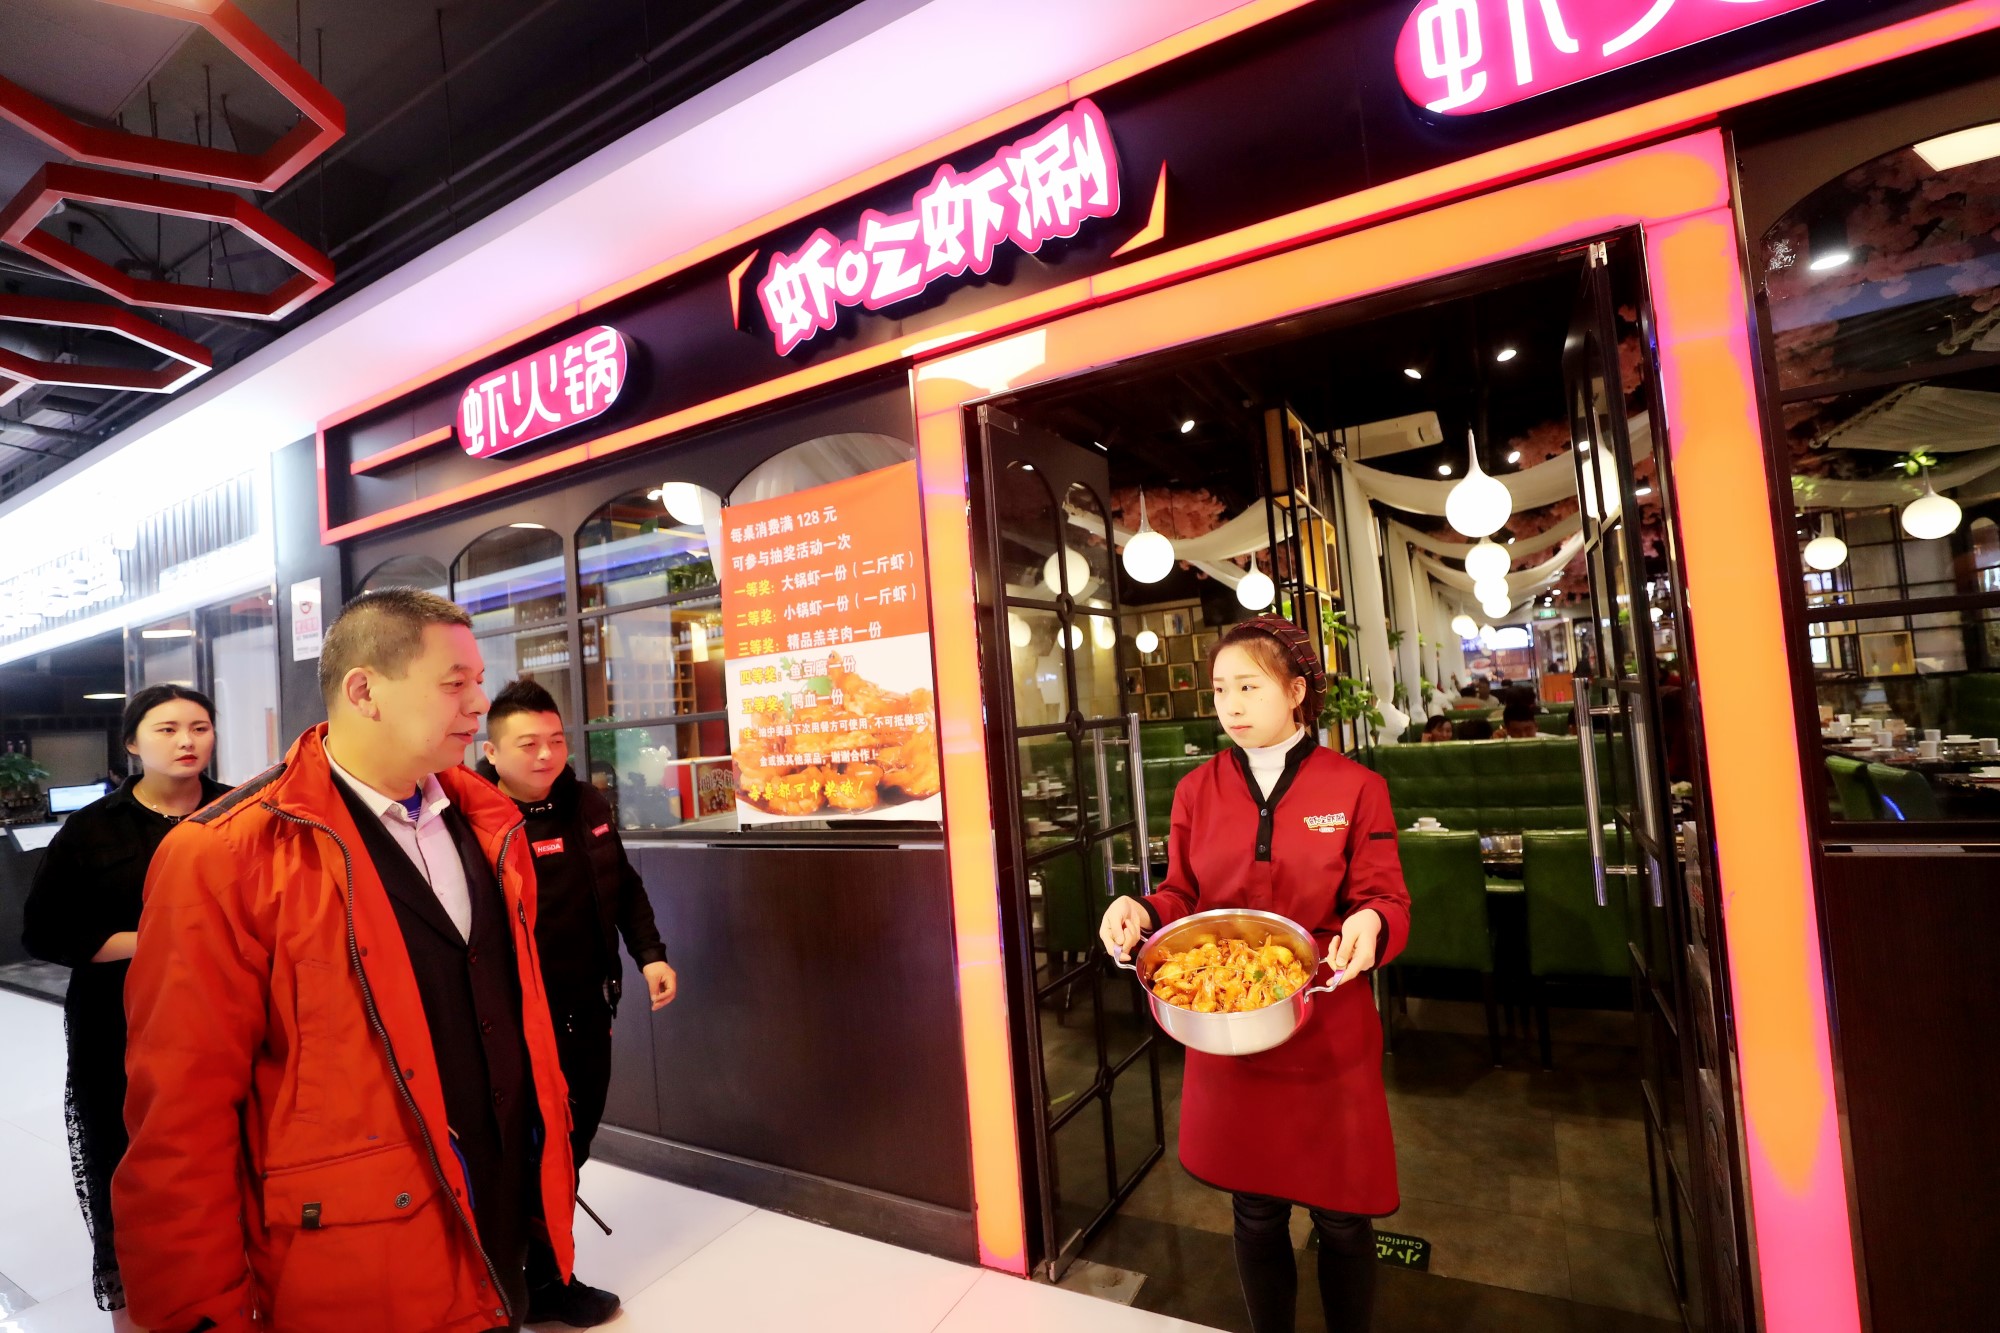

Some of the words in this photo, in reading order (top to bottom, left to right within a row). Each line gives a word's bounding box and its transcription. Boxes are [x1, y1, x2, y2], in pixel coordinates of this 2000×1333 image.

[1417, 0, 1767, 113] 虾
[462, 326, 620, 455] 虾火锅
[730, 514, 794, 544] 每桌消费满
[797, 510, 820, 528] 128
[823, 505, 838, 524] 元
[731, 533, 852, 572] 可参与抽奖活动一次
[733, 579, 776, 598] 一等奖：
[736, 608, 777, 627] 二等奖：
[738, 637, 780, 657] 三等奖：
[786, 621, 882, 651] 精品羔羊肉一份
[789, 655, 857, 681] 鱼豆腐一份
[791, 688, 844, 710] 鸭血一份
[1378, 1235, 1423, 1250] Caution
